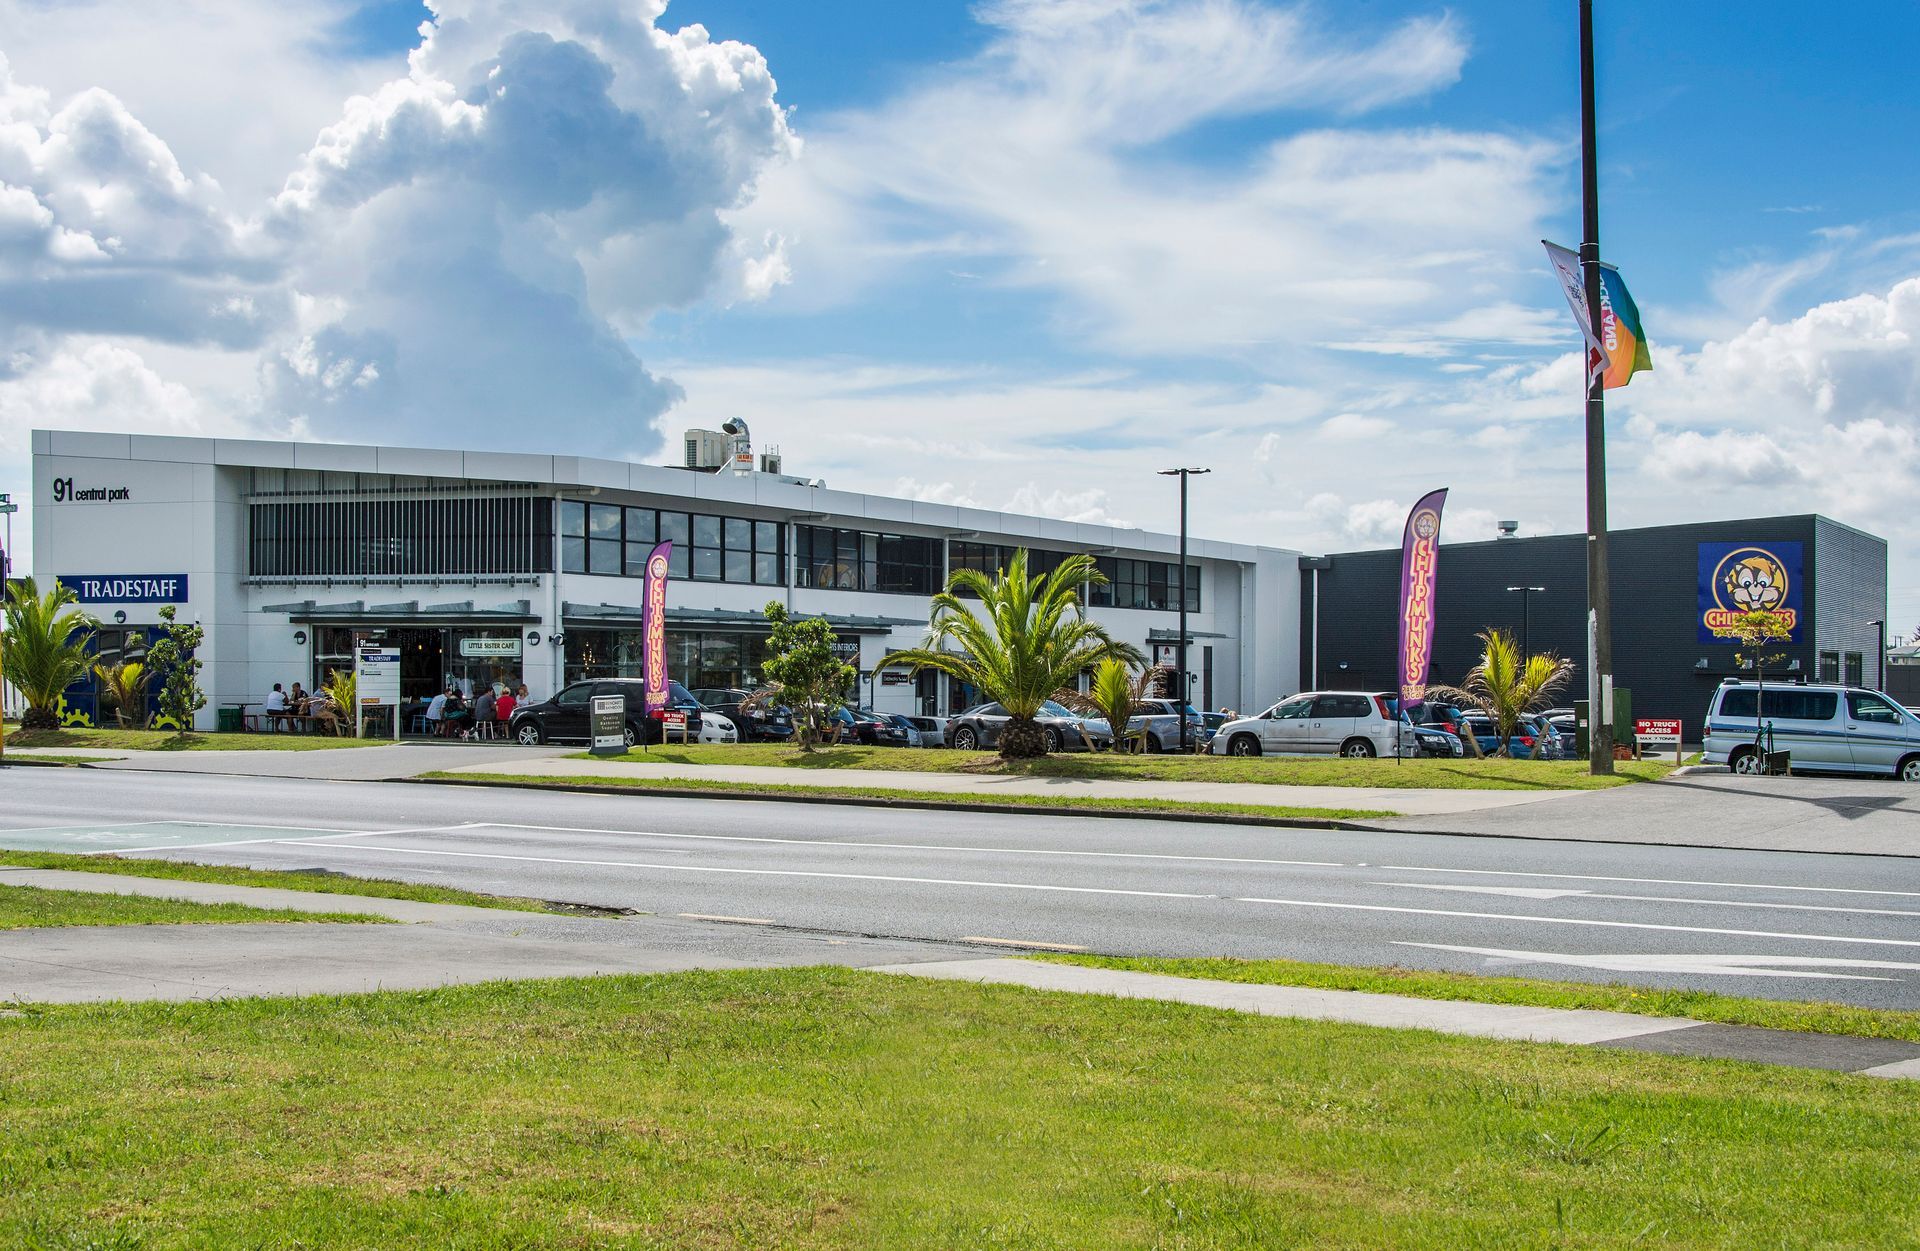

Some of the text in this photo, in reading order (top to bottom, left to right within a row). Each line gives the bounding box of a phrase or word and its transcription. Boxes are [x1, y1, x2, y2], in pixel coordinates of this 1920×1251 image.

[53, 477, 130, 502] 91 central park
[81, 579, 177, 598] TRADESTAFF
[1407, 539, 1432, 684] CHIPMUNKS
[1707, 611, 1793, 626] CHIPKS
[359, 639, 366, 647] 91
[649, 579, 665, 692] CHIPMUNKS
